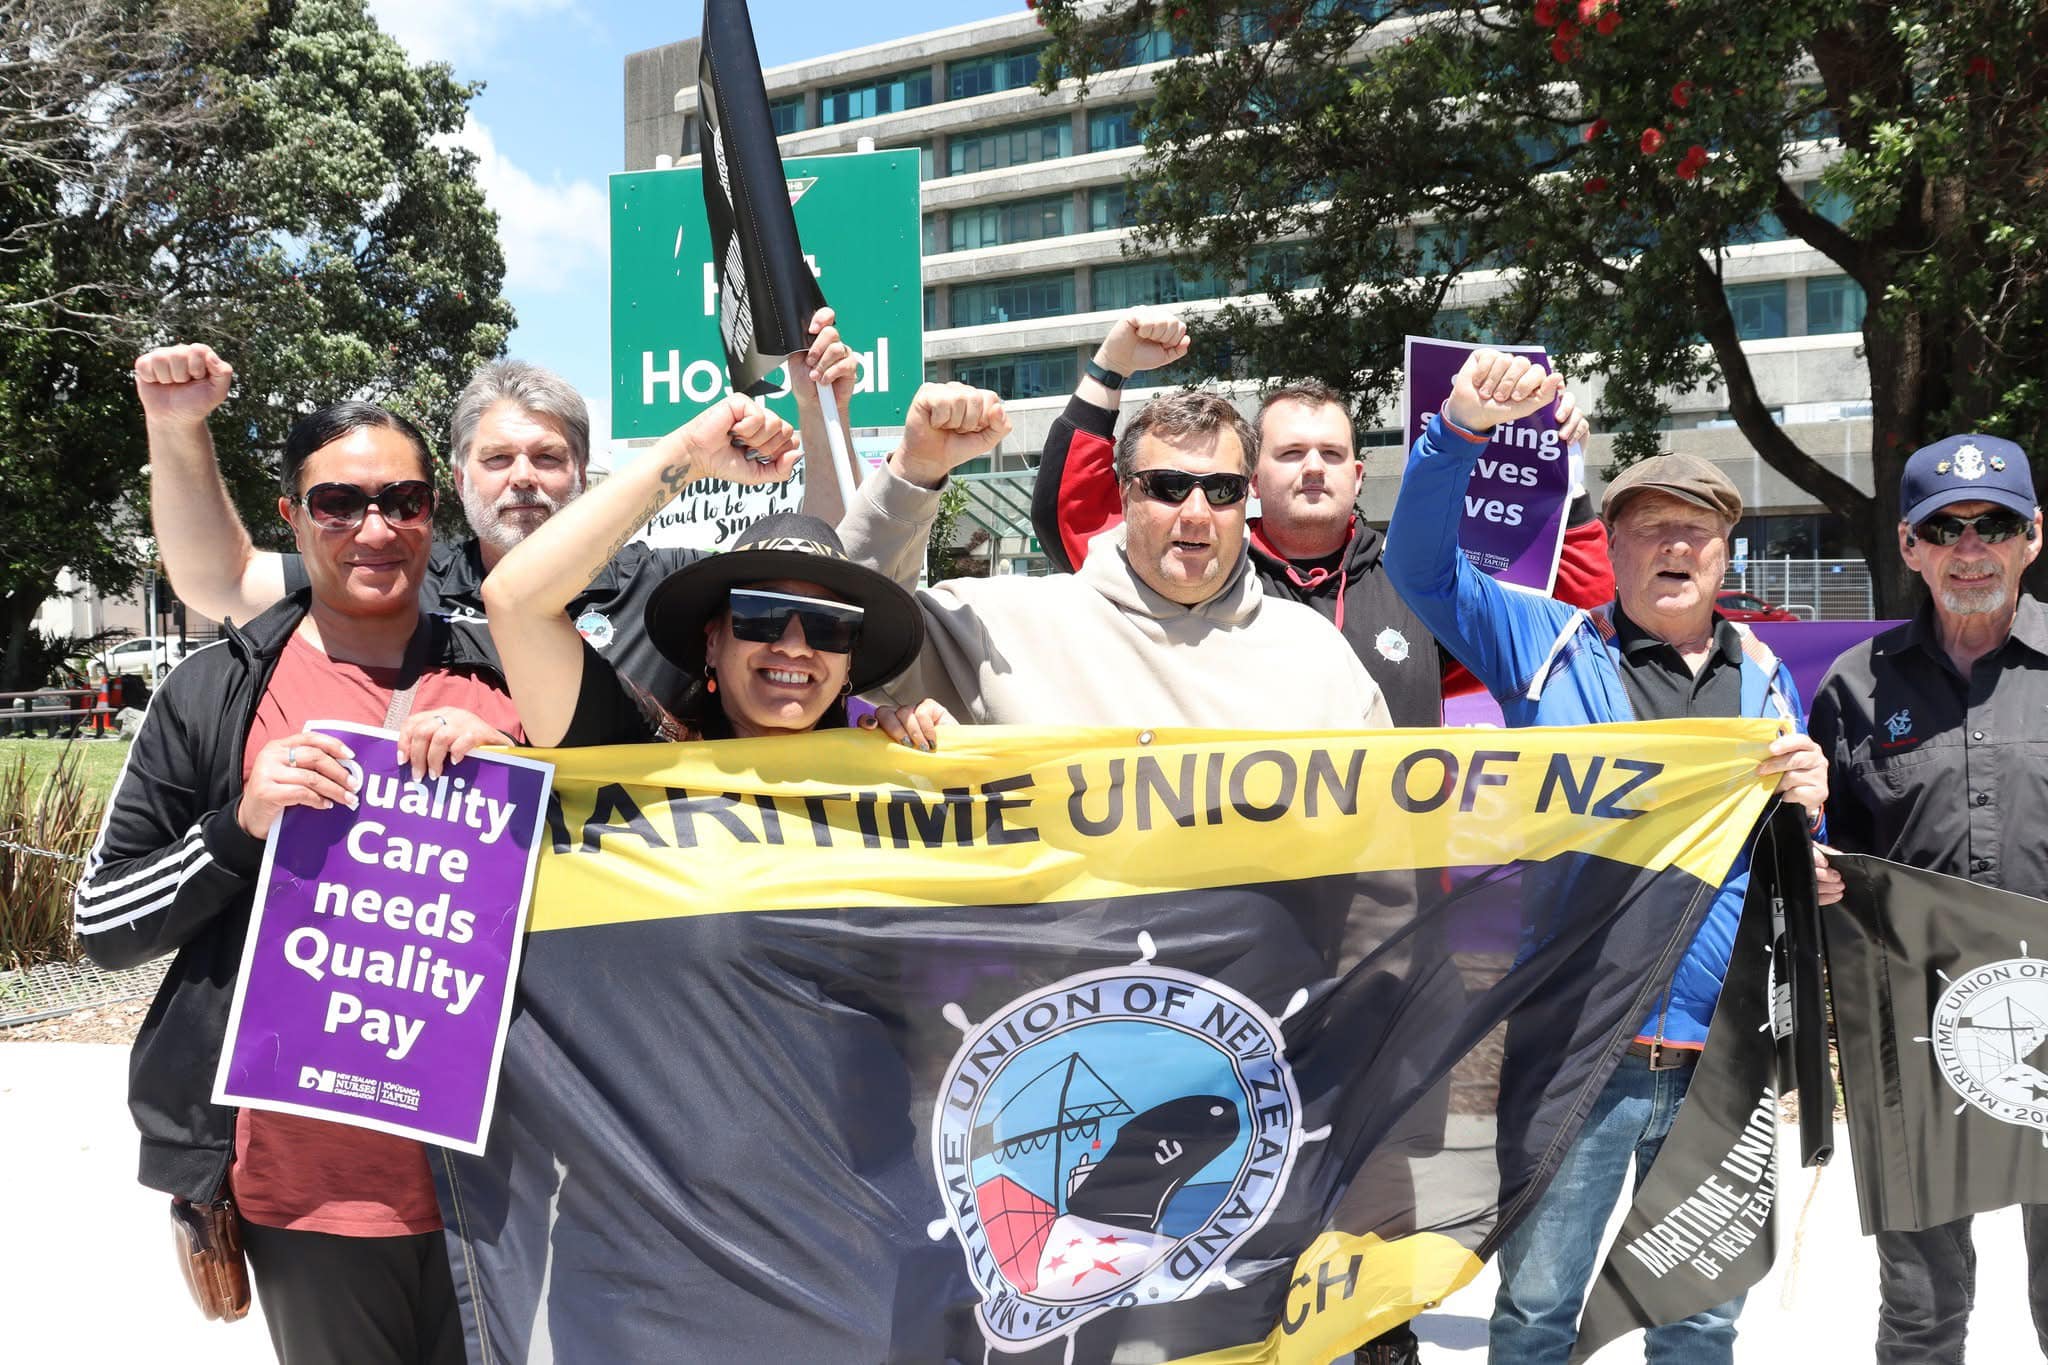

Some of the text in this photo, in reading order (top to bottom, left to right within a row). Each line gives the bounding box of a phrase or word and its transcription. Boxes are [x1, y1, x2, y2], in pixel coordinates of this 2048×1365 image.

[642, 337, 889, 408] Hopal
[1470, 458, 1538, 487] ves
[725, 494, 745, 516] be
[1464, 495, 1524, 526] ves
[1067, 749, 1367, 837] UNION
[1391, 748, 1520, 814] OF
[1535, 753, 1666, 820] NZ
[346, 821, 469, 883] Care
[313, 879, 476, 944] needs
[283, 926, 486, 1015] Quality
[1946, 966, 2012, 1011] UNION
[324, 991, 426, 1061] Pay
[335, 1079, 377, 1095] NURSES
[1938, 1014, 1999, 1110] MARITIME
[380, 1089, 420, 1107] TAPUHI
[949, 987, 1100, 1111] UNION
[1123, 982, 1196, 1018] OF
[1169, 1068, 1290, 1281] ZEALAND
[1625, 1086, 1776, 1279] MARITIME UNION
[1690, 1249, 1723, 1281] OF
[1708, 1219, 1757, 1262] NEW
